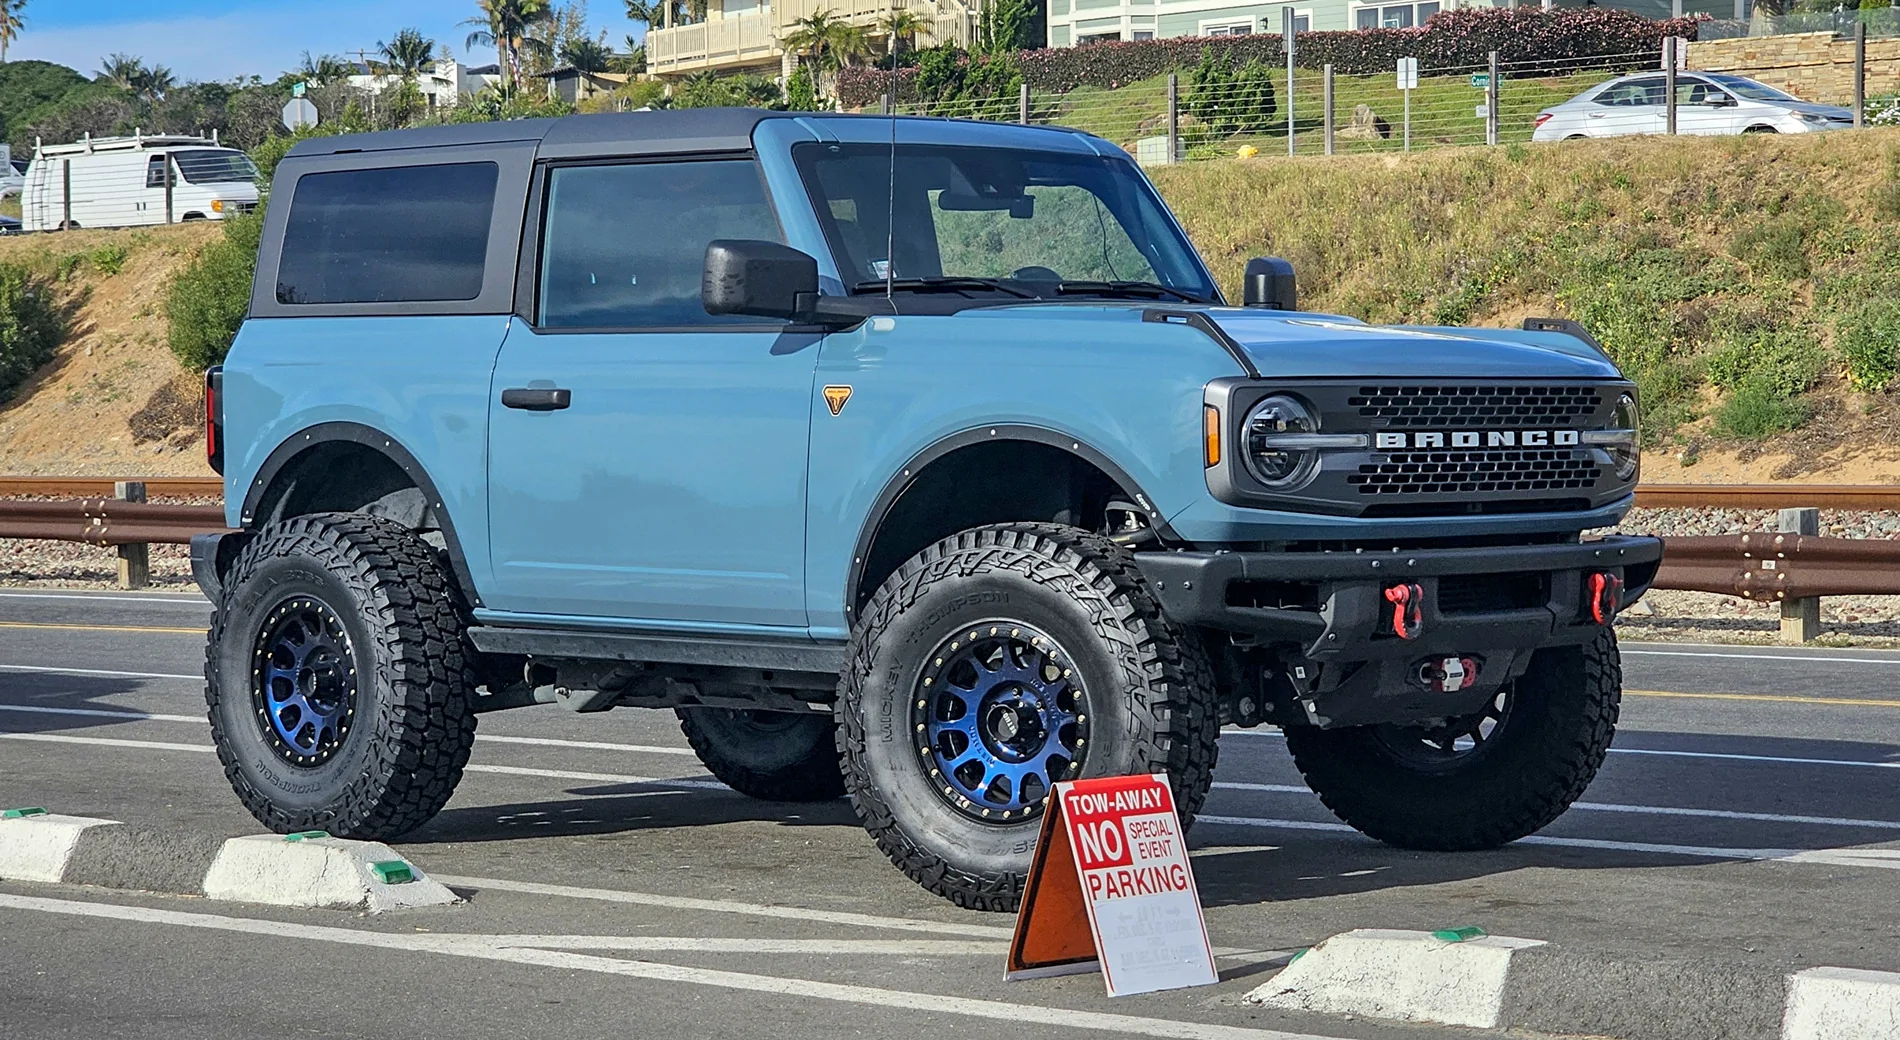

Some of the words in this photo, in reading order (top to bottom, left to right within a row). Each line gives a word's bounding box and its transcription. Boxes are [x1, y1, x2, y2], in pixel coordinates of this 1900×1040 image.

[1375, 430, 1579, 449] BRONCO
[906, 591, 1010, 644] THOMPSON
[881, 657, 903, 743] MICKEY
[1068, 787, 1162, 816] TOW-AWAY
[1077, 819, 1123, 864] NO
[1129, 818, 1173, 839] SPECIAL
[1138, 839, 1173, 860] EVENT
[1087, 863, 1188, 900] PARKING
